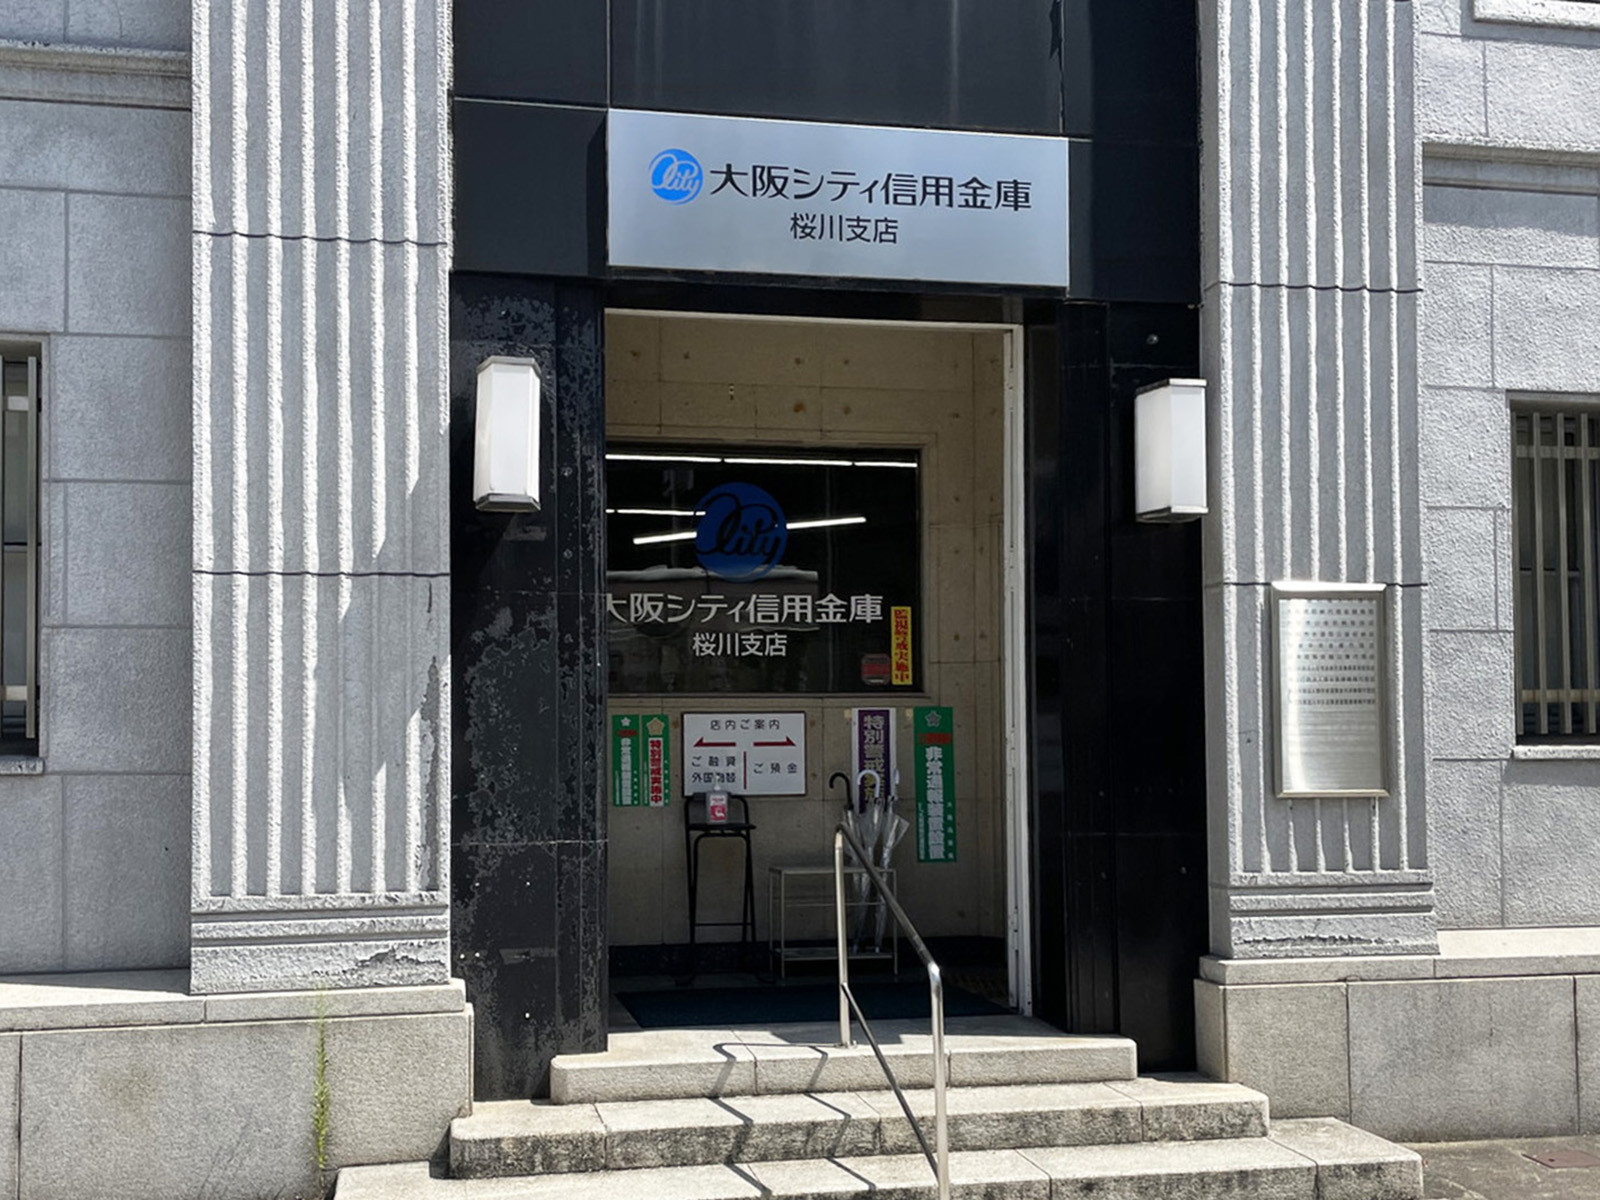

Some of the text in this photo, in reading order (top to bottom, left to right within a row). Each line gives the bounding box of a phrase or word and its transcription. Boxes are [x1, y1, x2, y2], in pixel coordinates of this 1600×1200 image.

[710, 162, 1033, 212] 大阪シティ信用金庫
[790, 212, 899, 244] 桜川支店
[693, 632, 787, 657] 桜川支店
[710, 719, 780, 731] 店内ご案内
[691, 755, 736, 767] ご融資
[753, 763, 798, 774] ご預金
